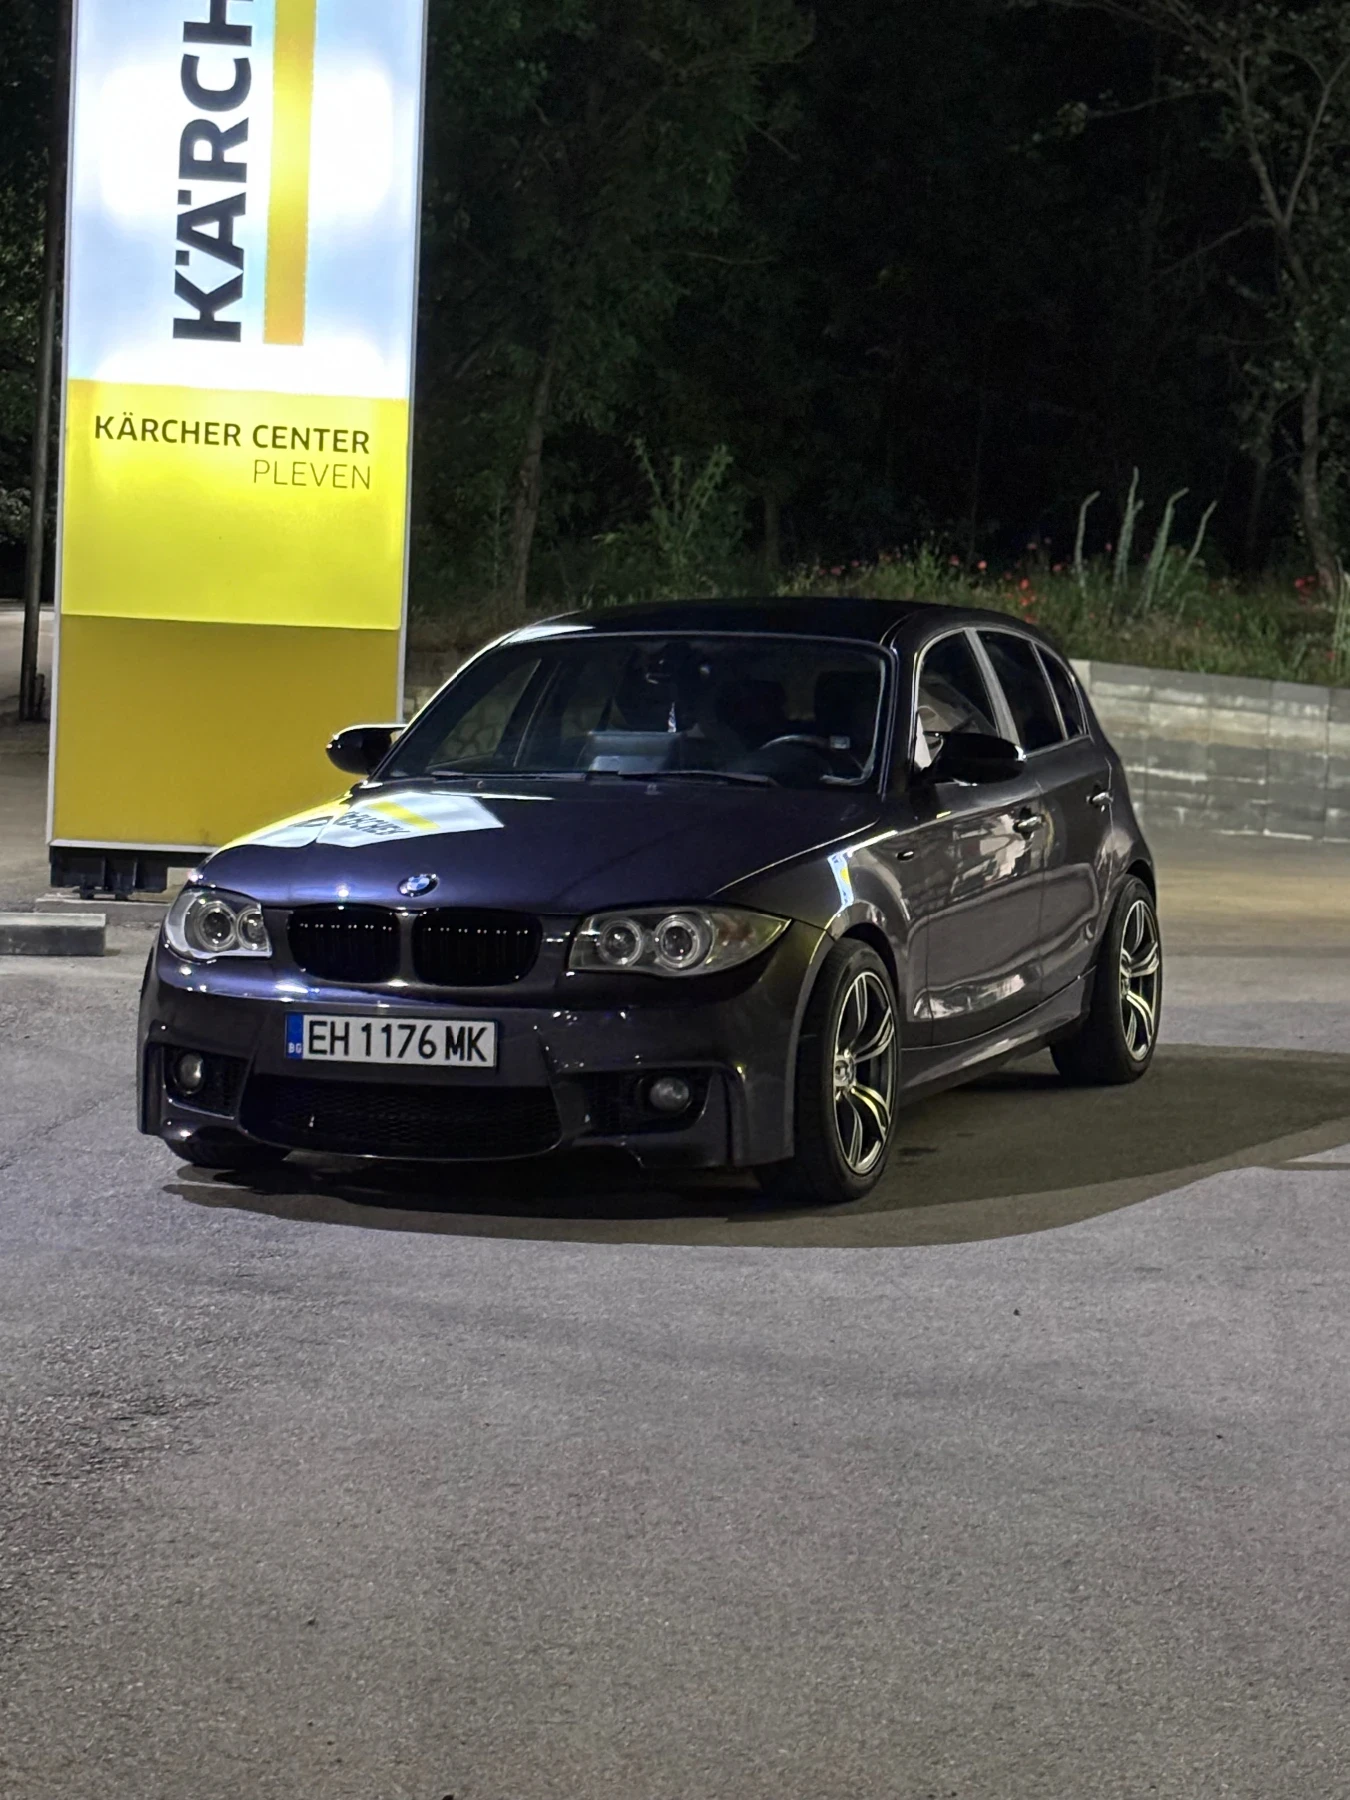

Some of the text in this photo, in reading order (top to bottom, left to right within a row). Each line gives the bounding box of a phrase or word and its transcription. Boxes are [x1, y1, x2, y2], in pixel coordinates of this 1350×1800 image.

[95, 411, 370, 454] KÄRCHER CENTER
[253, 459, 371, 490] PLEVEN
[288, 1042, 302, 1054] BG
[309, 1020, 487, 1062] EH 1176 MK
